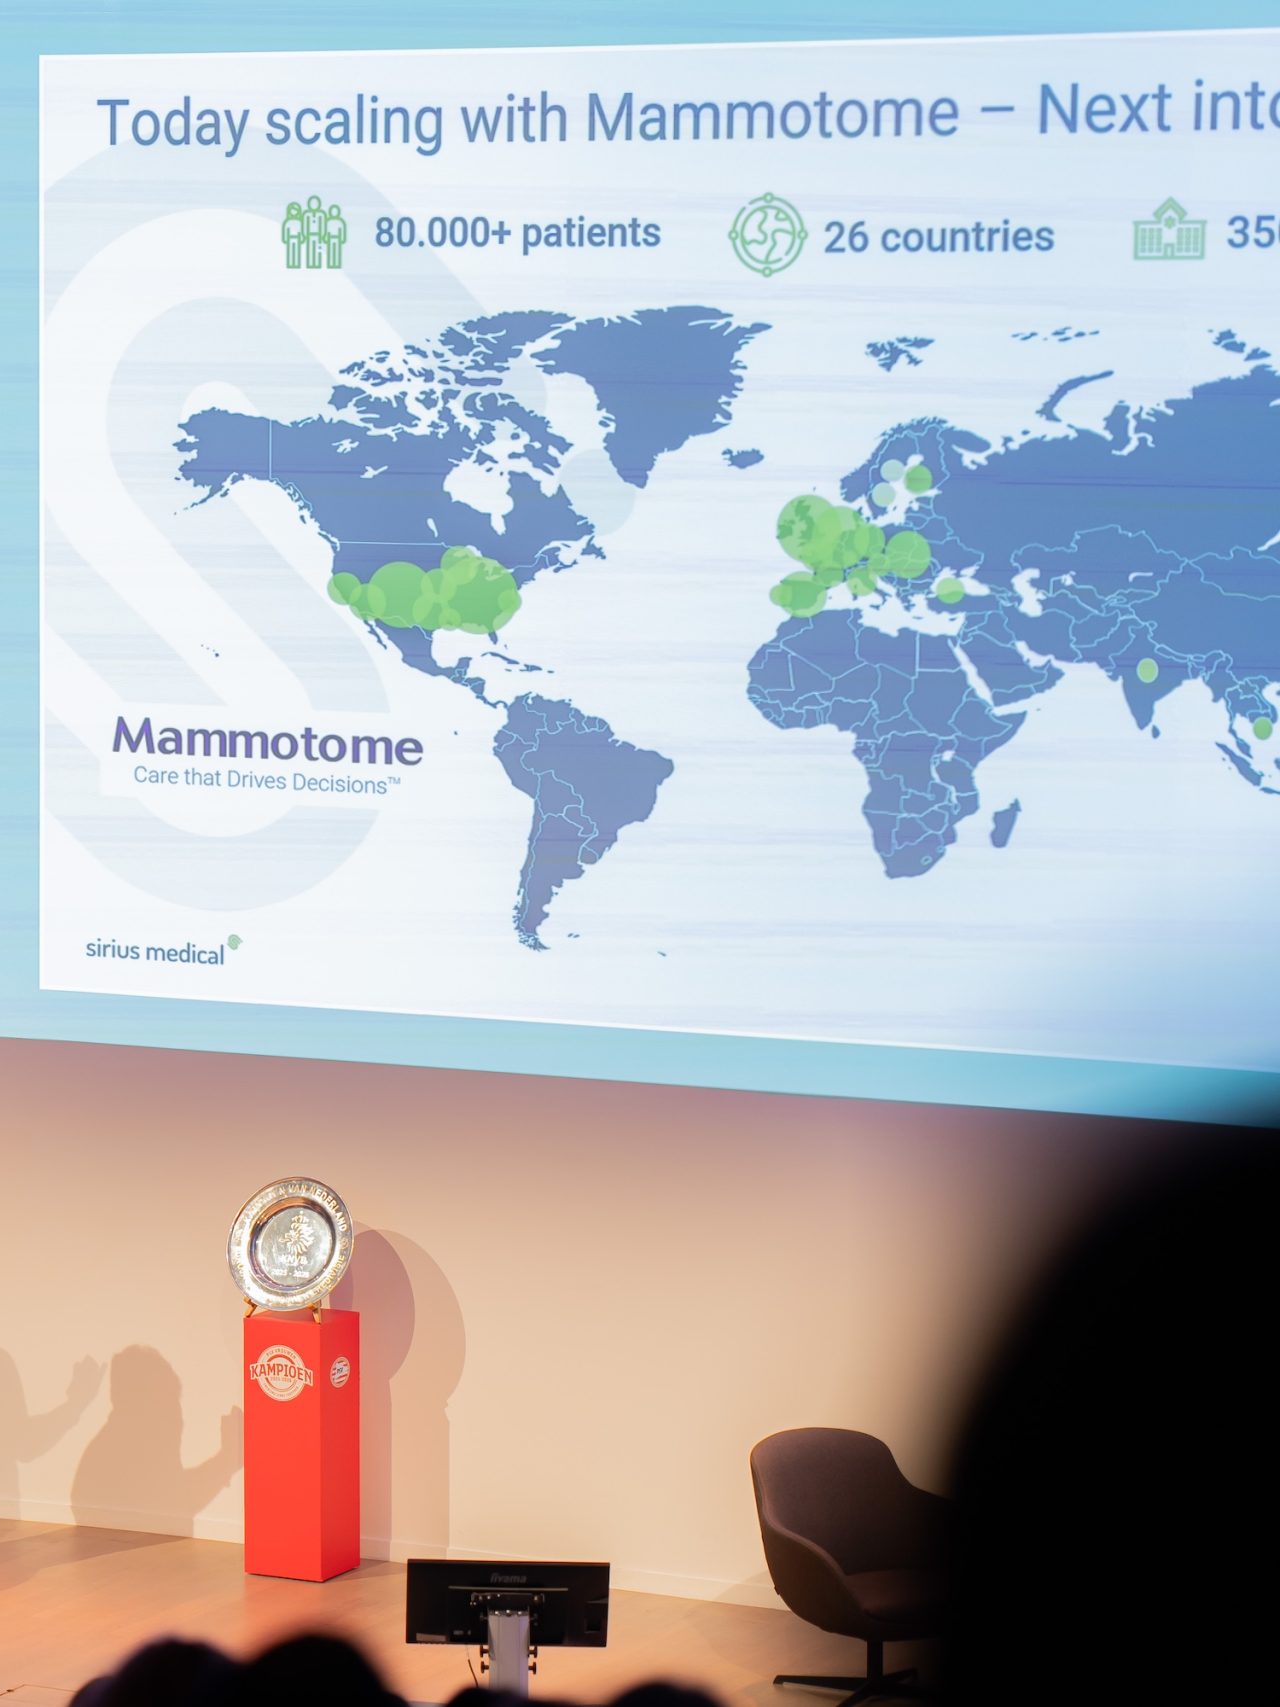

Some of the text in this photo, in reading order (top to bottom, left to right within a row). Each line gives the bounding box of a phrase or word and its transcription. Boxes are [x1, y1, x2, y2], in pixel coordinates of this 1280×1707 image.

[97, 97, 249, 158] Today
[266, 93, 442, 156] scaling
[461, 91, 567, 143] with
[588, 91, 959, 141] Mammotome
[1039, 82, 1172, 134] Next
[376, 215, 661, 256] 80.000+ patients
[825, 219, 1054, 253] 26 countries
[1227, 215, 1280, 248] 35
[112, 716, 423, 766] Mammotome
[134, 766, 179, 784] Care
[184, 767, 221, 787] that
[227, 770, 287, 790] Drives
[86, 938, 224, 965] sirius medical
[309, 1187, 349, 1232] NEDERLAND
[250, 1363, 312, 1384] KAMPIOEN
